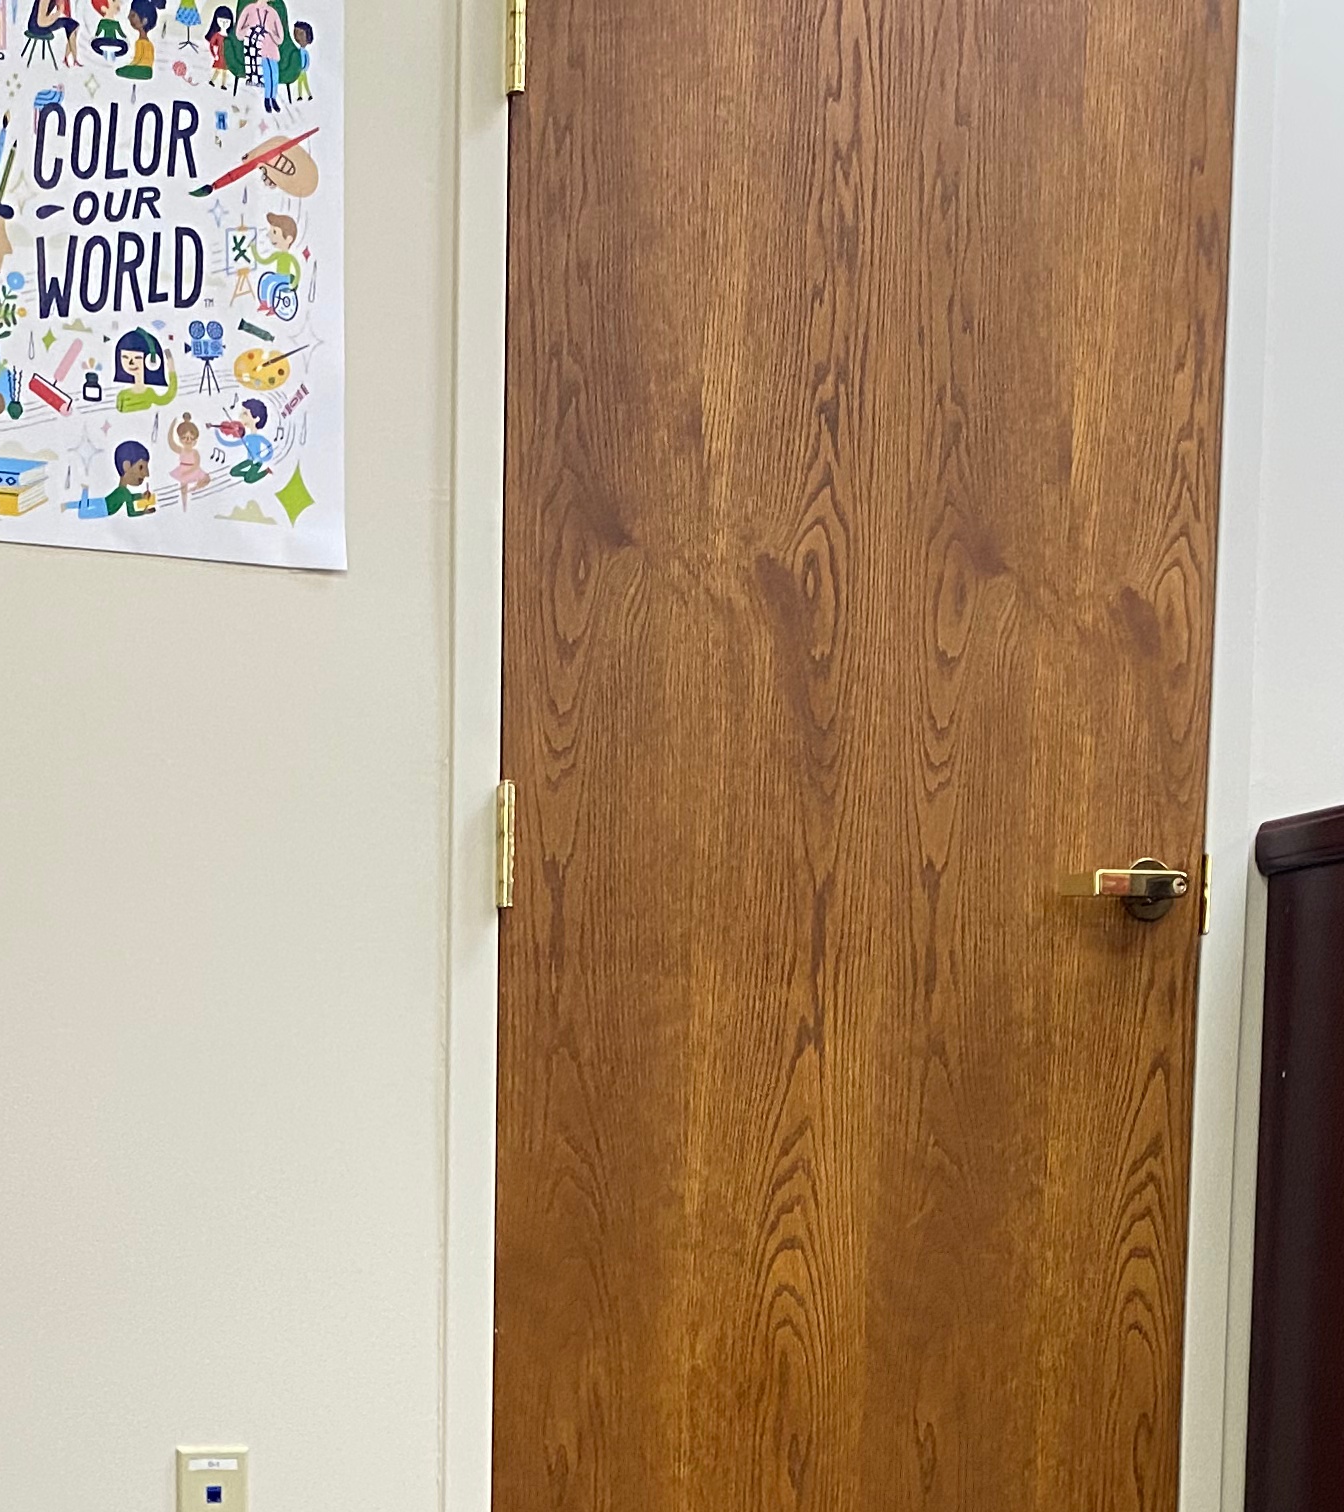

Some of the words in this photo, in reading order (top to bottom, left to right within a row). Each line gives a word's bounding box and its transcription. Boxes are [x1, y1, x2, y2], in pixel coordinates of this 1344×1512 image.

[34, 100, 199, 189] COLOR
[72, 186, 161, 226] OUR
[36, 227, 204, 319] WORLD
